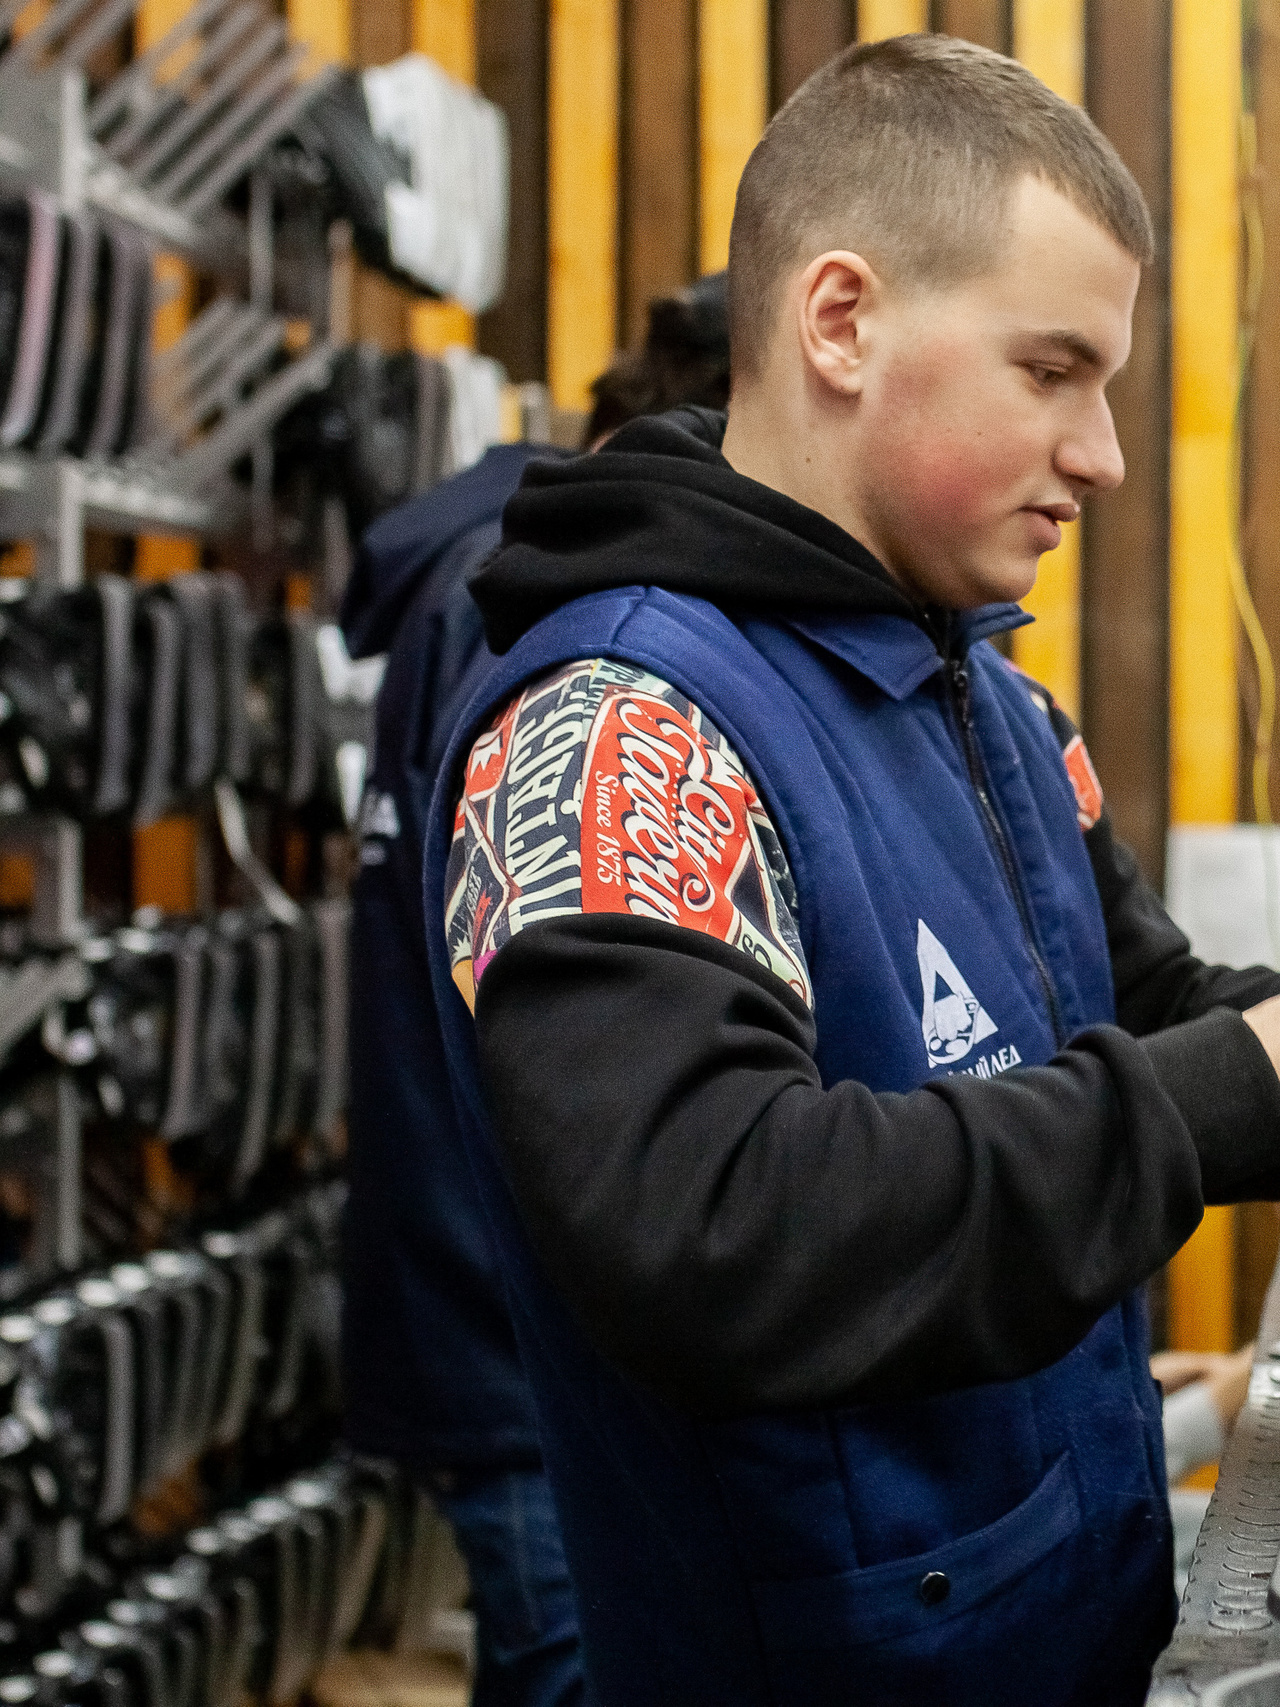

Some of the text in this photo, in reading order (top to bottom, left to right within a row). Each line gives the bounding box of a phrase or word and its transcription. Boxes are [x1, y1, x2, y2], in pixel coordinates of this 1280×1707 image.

[595, 771, 621, 886] Since 1875
[620, 701, 709, 927] Tavern
[680, 779, 735, 912] City
